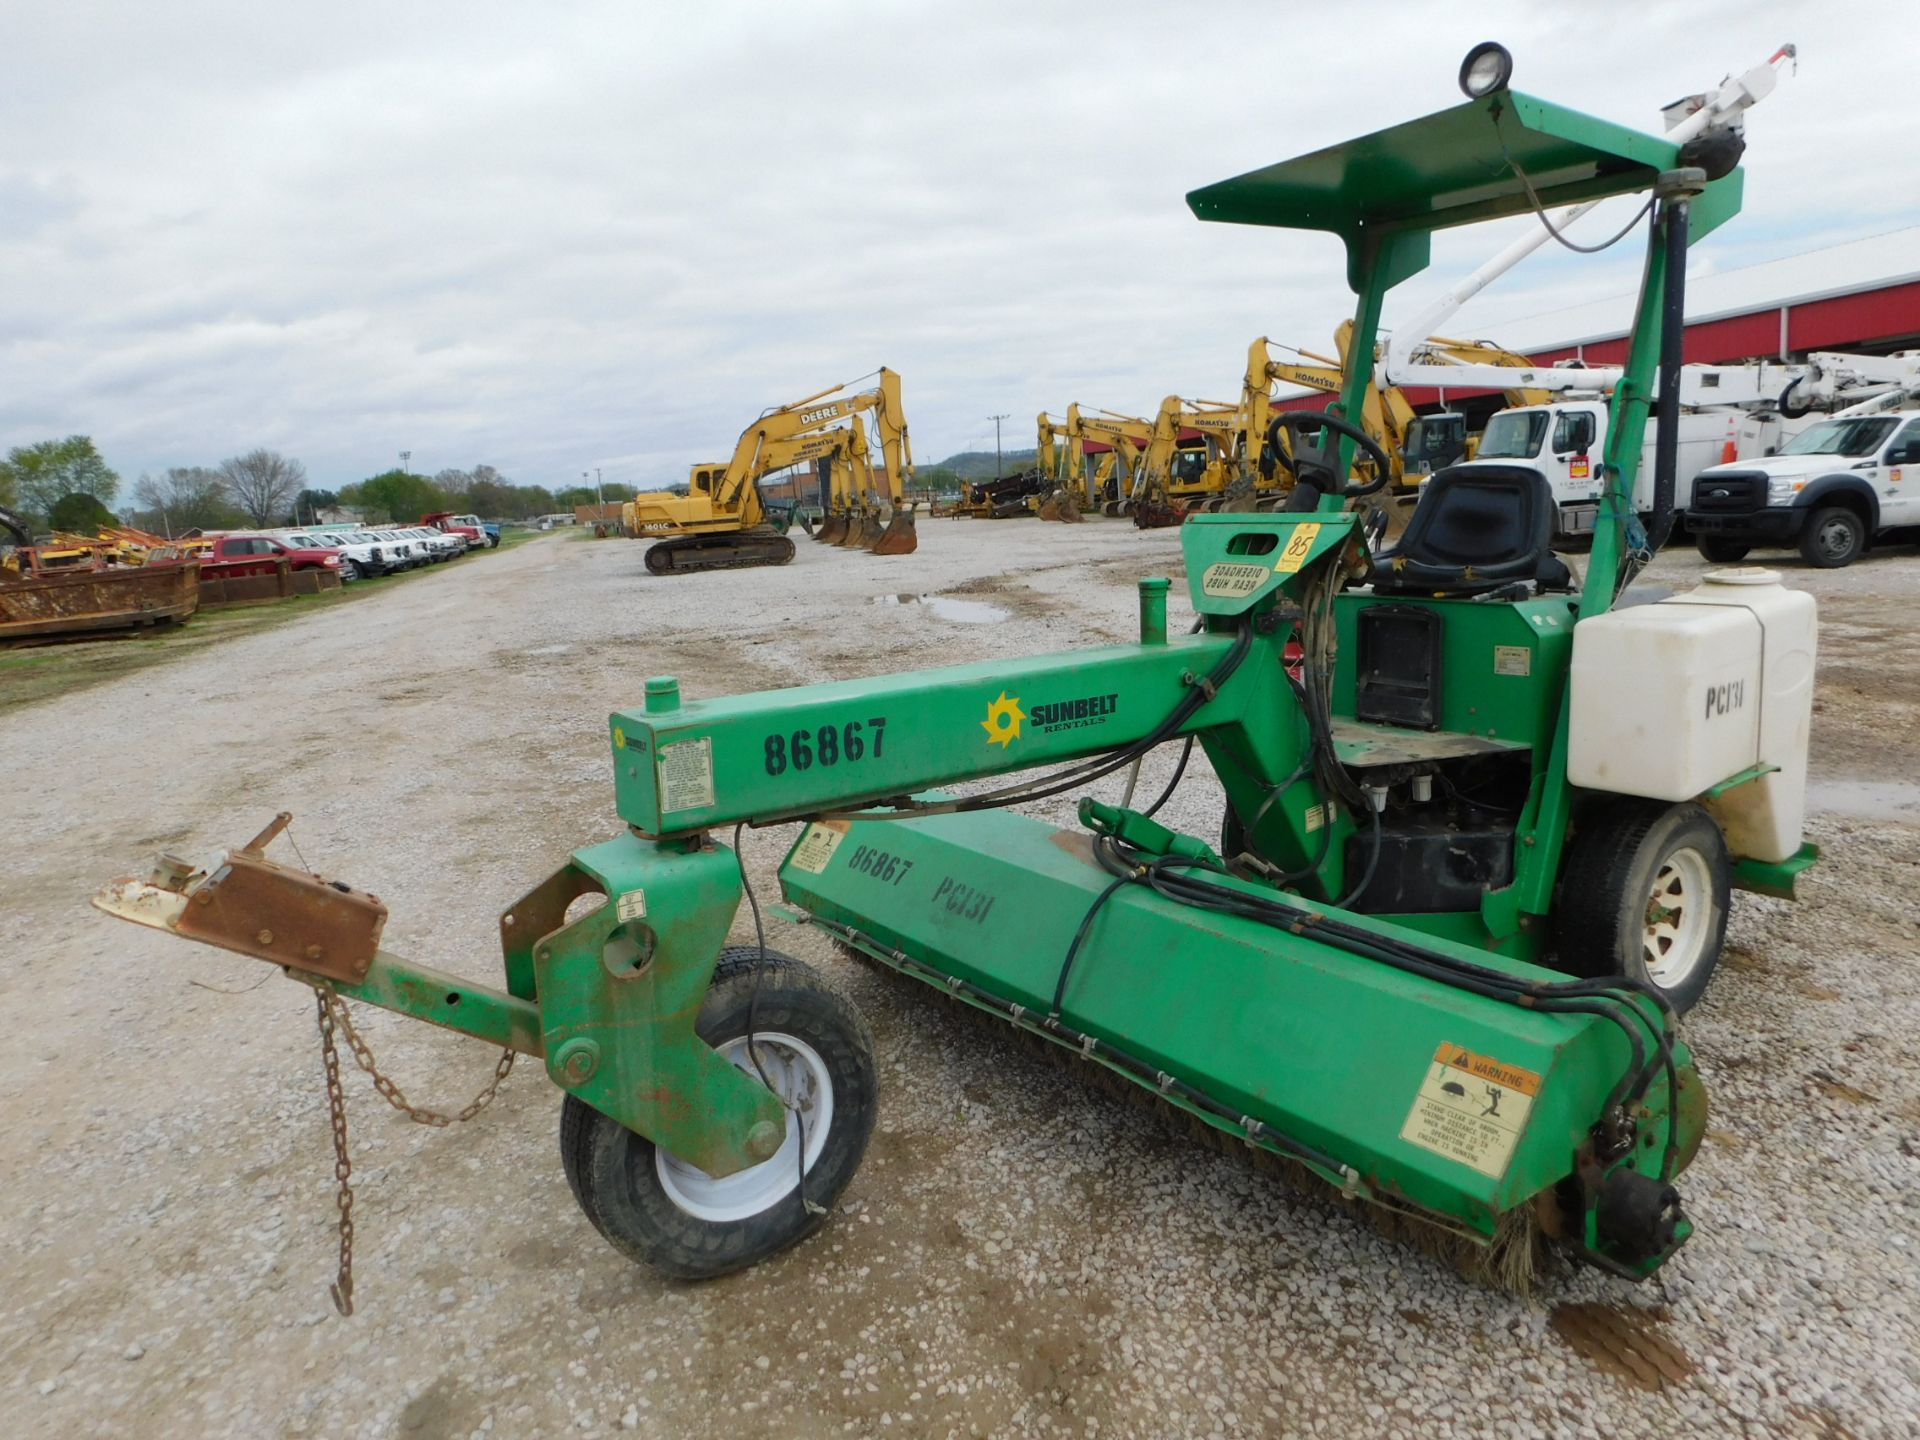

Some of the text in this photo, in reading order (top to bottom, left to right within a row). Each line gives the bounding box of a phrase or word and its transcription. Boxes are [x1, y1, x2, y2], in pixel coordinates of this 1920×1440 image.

[1295, 371, 1335, 388] KOMATSU
[801, 406, 839, 424] DEERE
[1195, 419, 1229, 427] KOMATSU
[1288, 535, 1314, 556] 85
[1030, 693, 1119, 727] SUNBELT
[1044, 717, 1106, 733] RENTALS
[764, 717, 887, 776] 86867
[848, 844, 914, 886] 86867
[1473, 1061, 1524, 1088] WARNING
[1447, 1110, 1466, 1121] CLEAR
